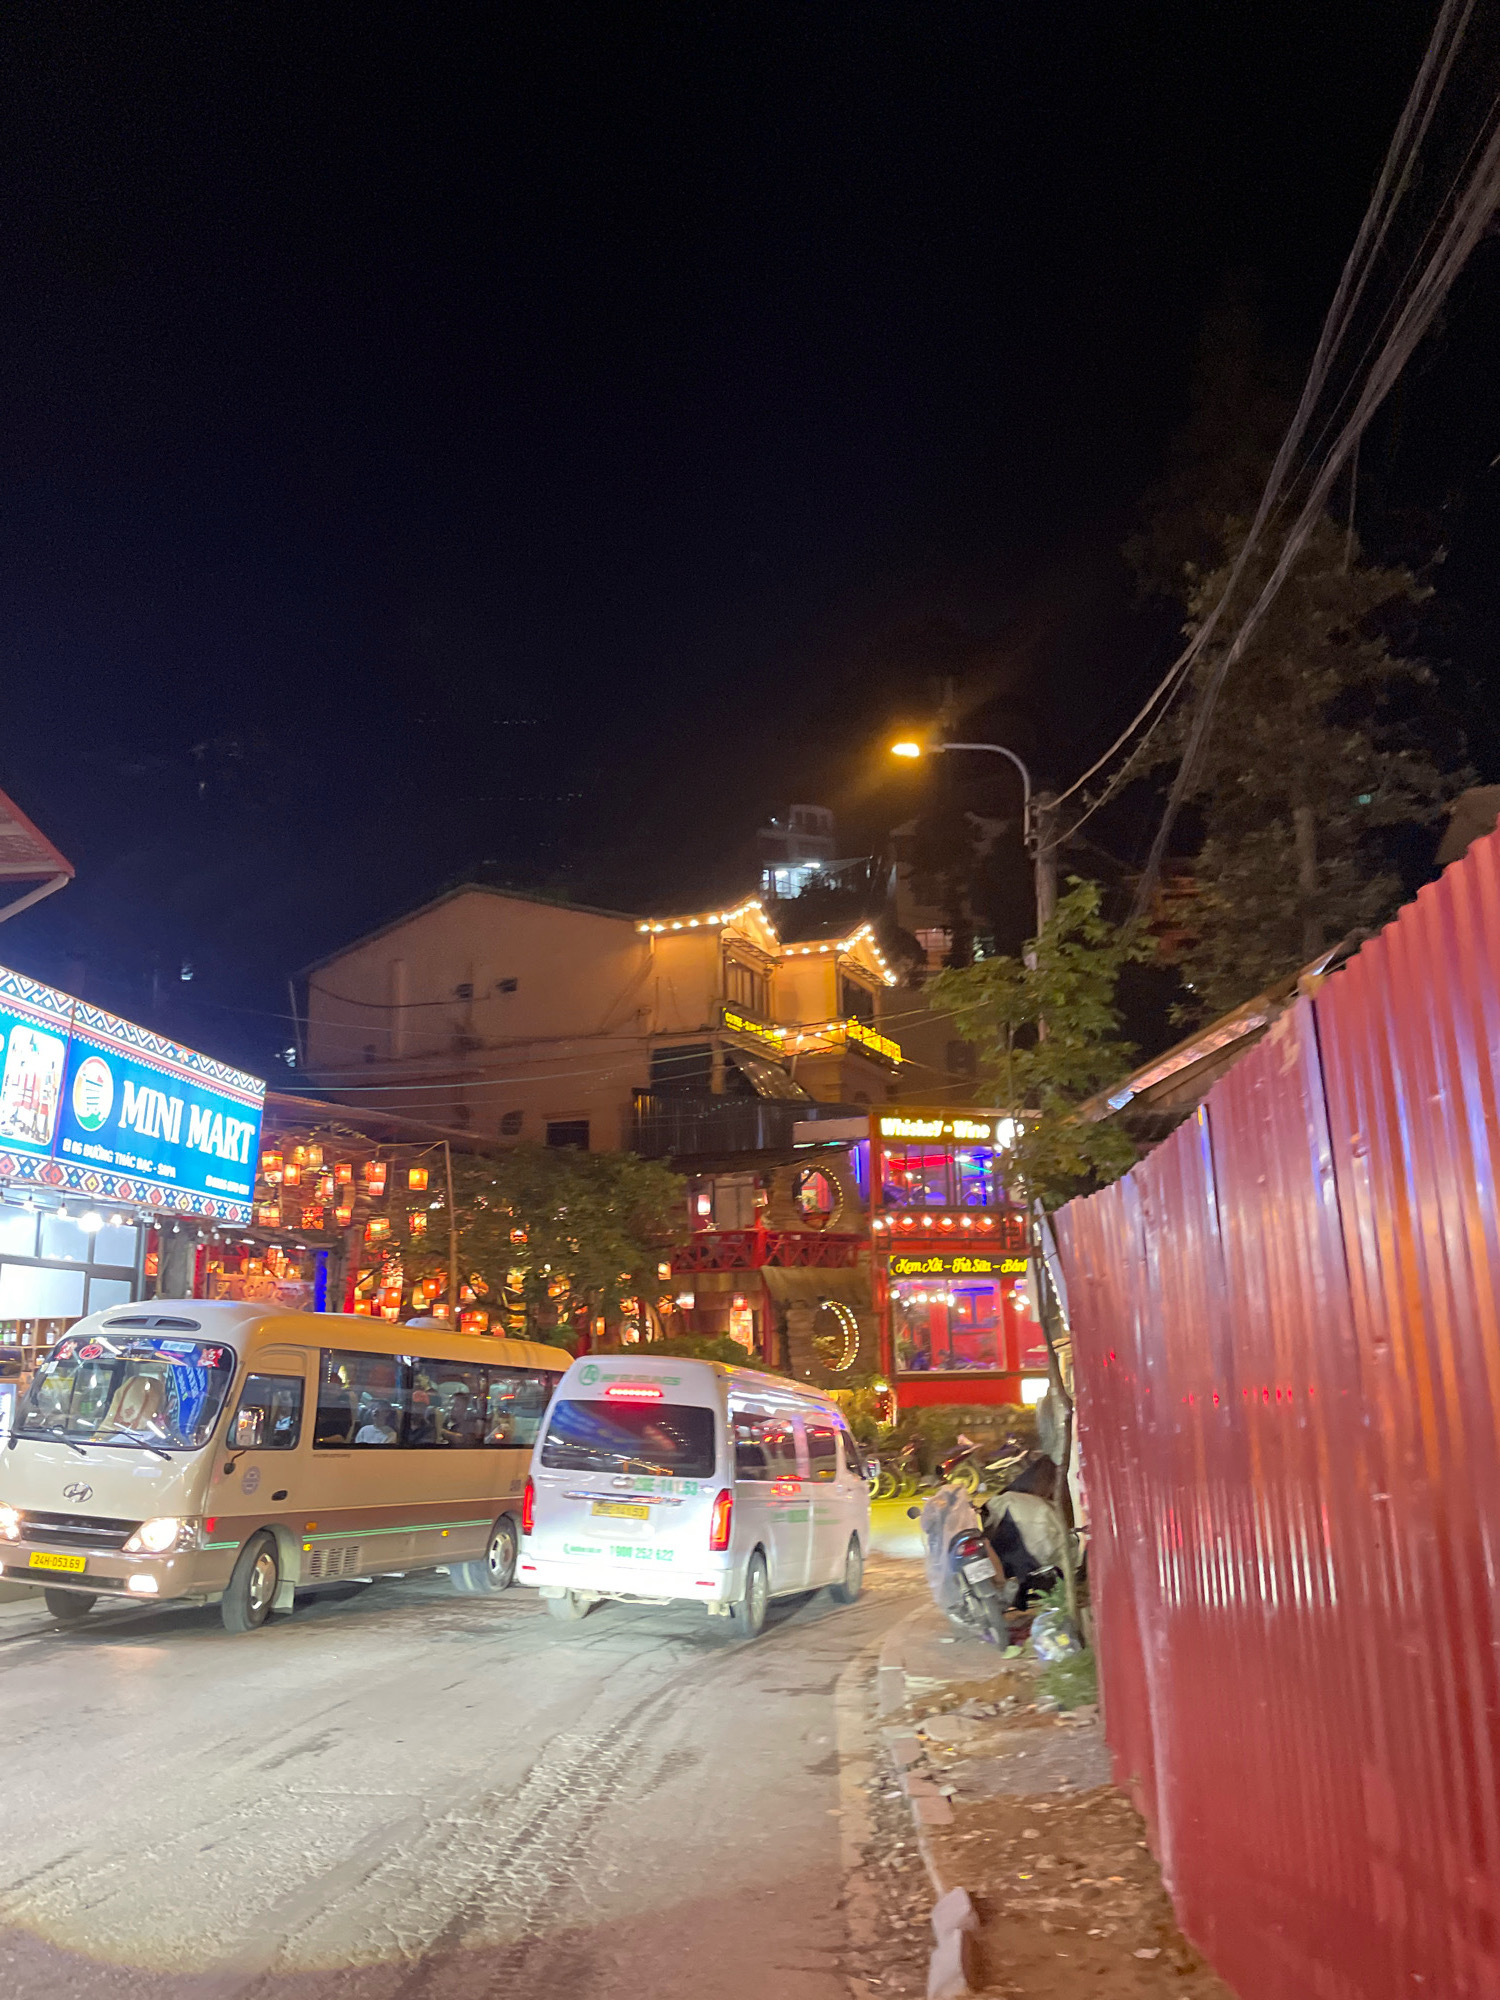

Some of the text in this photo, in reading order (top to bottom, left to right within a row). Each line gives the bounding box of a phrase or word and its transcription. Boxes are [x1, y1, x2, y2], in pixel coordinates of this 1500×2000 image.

[118, 1080, 256, 1164] MINI MART
[953, 1120, 990, 1138] Wine
